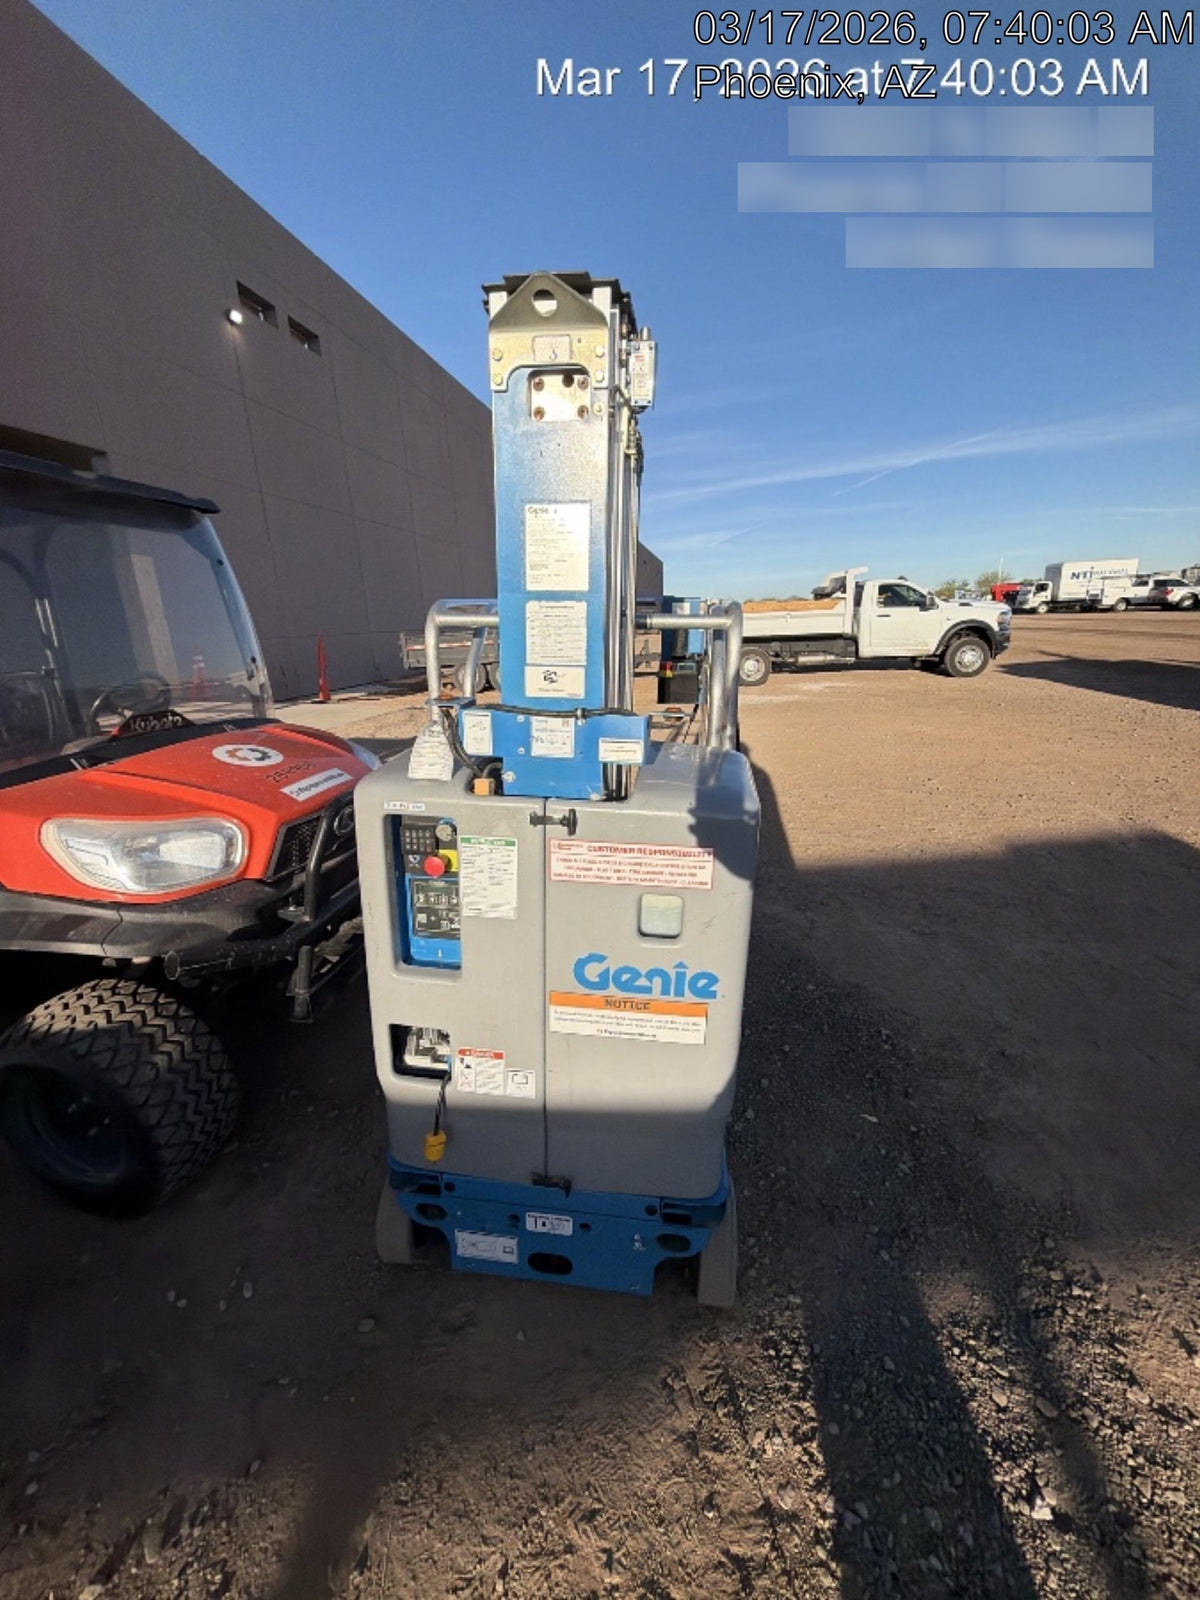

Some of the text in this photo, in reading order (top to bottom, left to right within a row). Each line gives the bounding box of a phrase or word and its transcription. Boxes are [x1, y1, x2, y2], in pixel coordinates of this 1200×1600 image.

[586, 845, 635, 855] CUSTOMER
[573, 952, 720, 1000] Genie
[605, 999, 651, 1011] NOTICE
